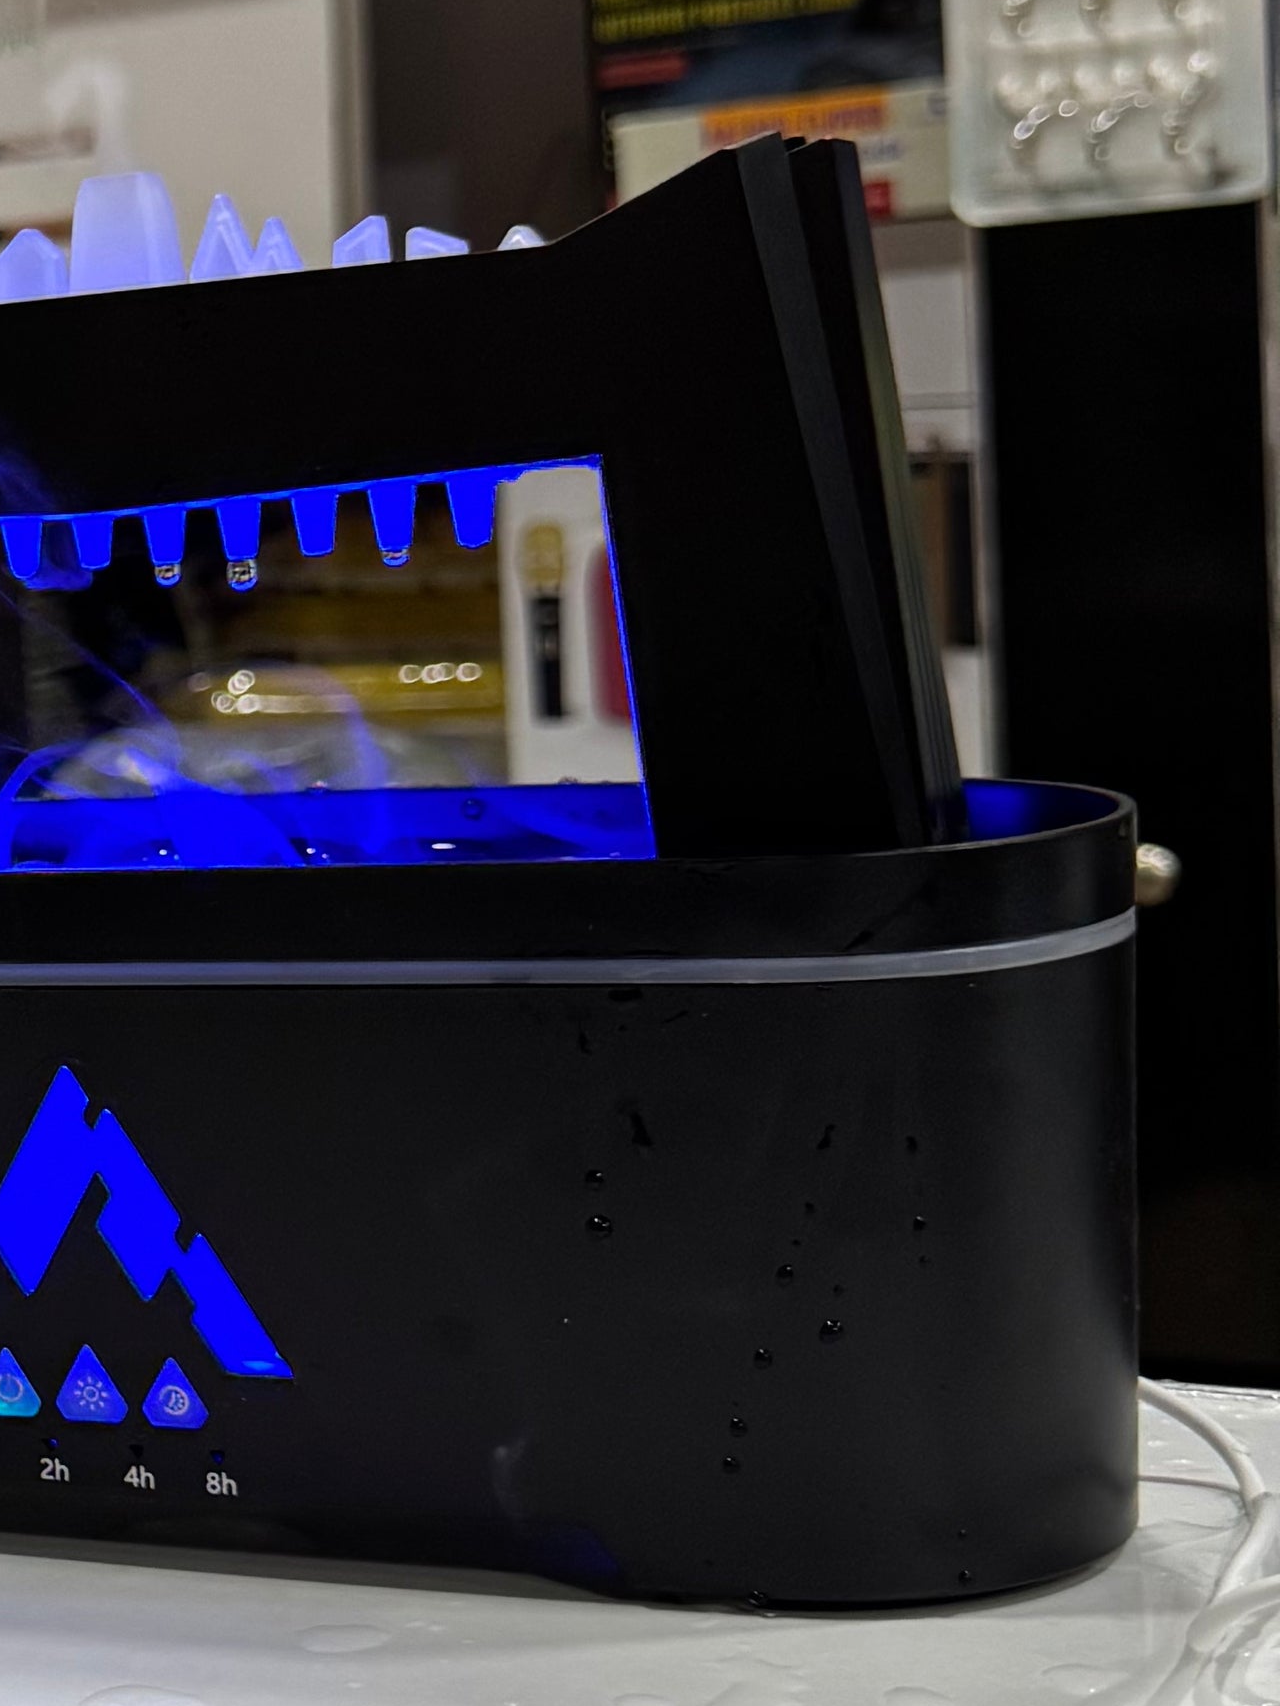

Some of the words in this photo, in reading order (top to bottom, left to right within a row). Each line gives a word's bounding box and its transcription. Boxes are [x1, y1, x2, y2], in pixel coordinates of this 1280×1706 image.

[40, 1458, 70, 1482] 2h
[124, 1465, 155, 1490] 4h
[205, 1472, 238, 1496] 8h
